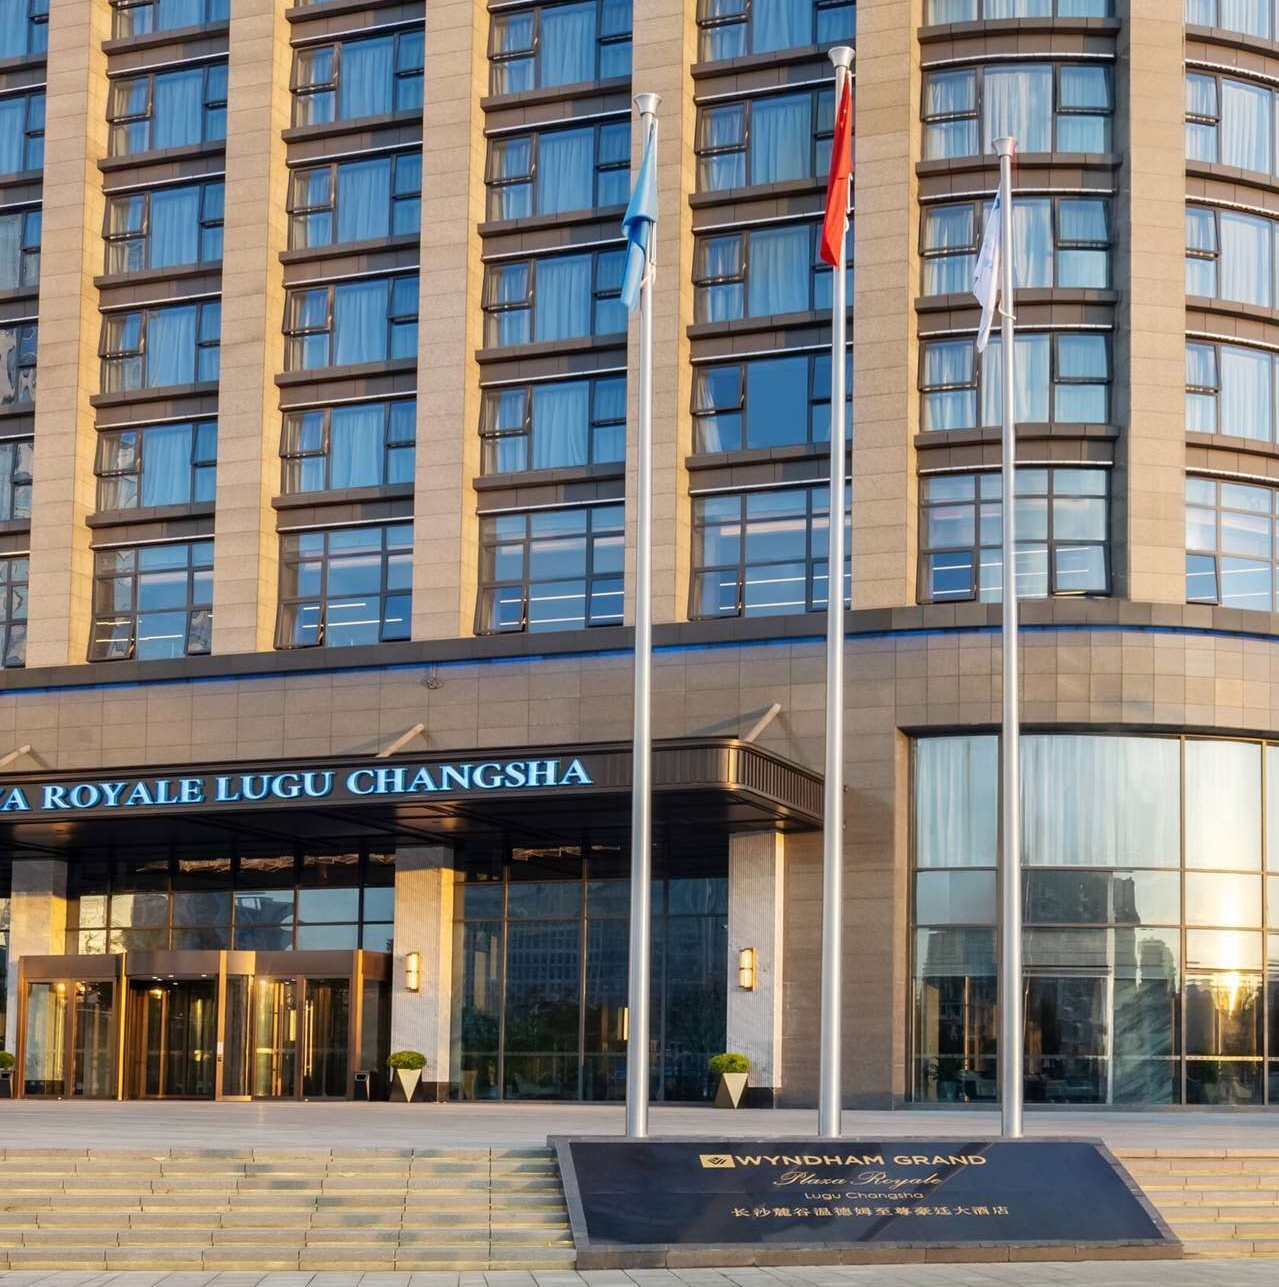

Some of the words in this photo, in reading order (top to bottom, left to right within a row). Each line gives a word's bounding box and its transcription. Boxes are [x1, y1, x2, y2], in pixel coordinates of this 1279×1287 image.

[43, 778, 205, 810] ROYALE
[215, 771, 336, 802] LUGU
[346, 758, 593, 796] CHANGSHA
[735, 1154, 885, 1166] WYNDHAM
[893, 1154, 987, 1166] GRAND
[773, 1171, 848, 1186] Plaza
[850, 1171, 942, 1188] Royale
[804, 1192, 841, 1201] Lugu
[845, 1192, 924, 1201] Changsha
